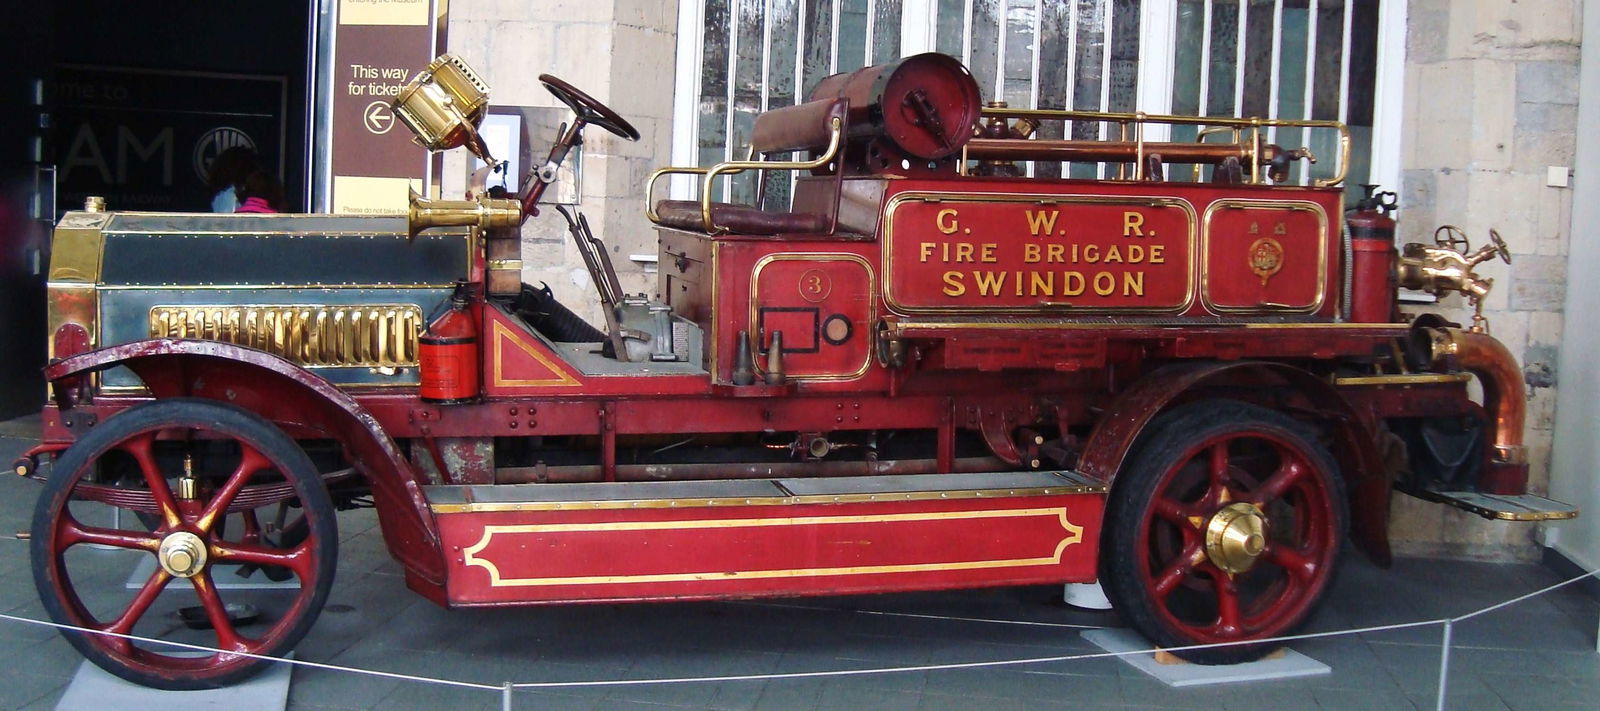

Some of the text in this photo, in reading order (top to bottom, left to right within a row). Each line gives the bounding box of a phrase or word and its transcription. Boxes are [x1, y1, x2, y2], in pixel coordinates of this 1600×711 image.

[350, 64, 409, 82] This way
[348, 81, 366, 96] for
[936, 208, 1156, 237] G. W. R.
[920, 242, 1166, 264] FIRE BRIGADE
[808, 275, 822, 294] 3
[942, 271, 1145, 297] SWINDON
